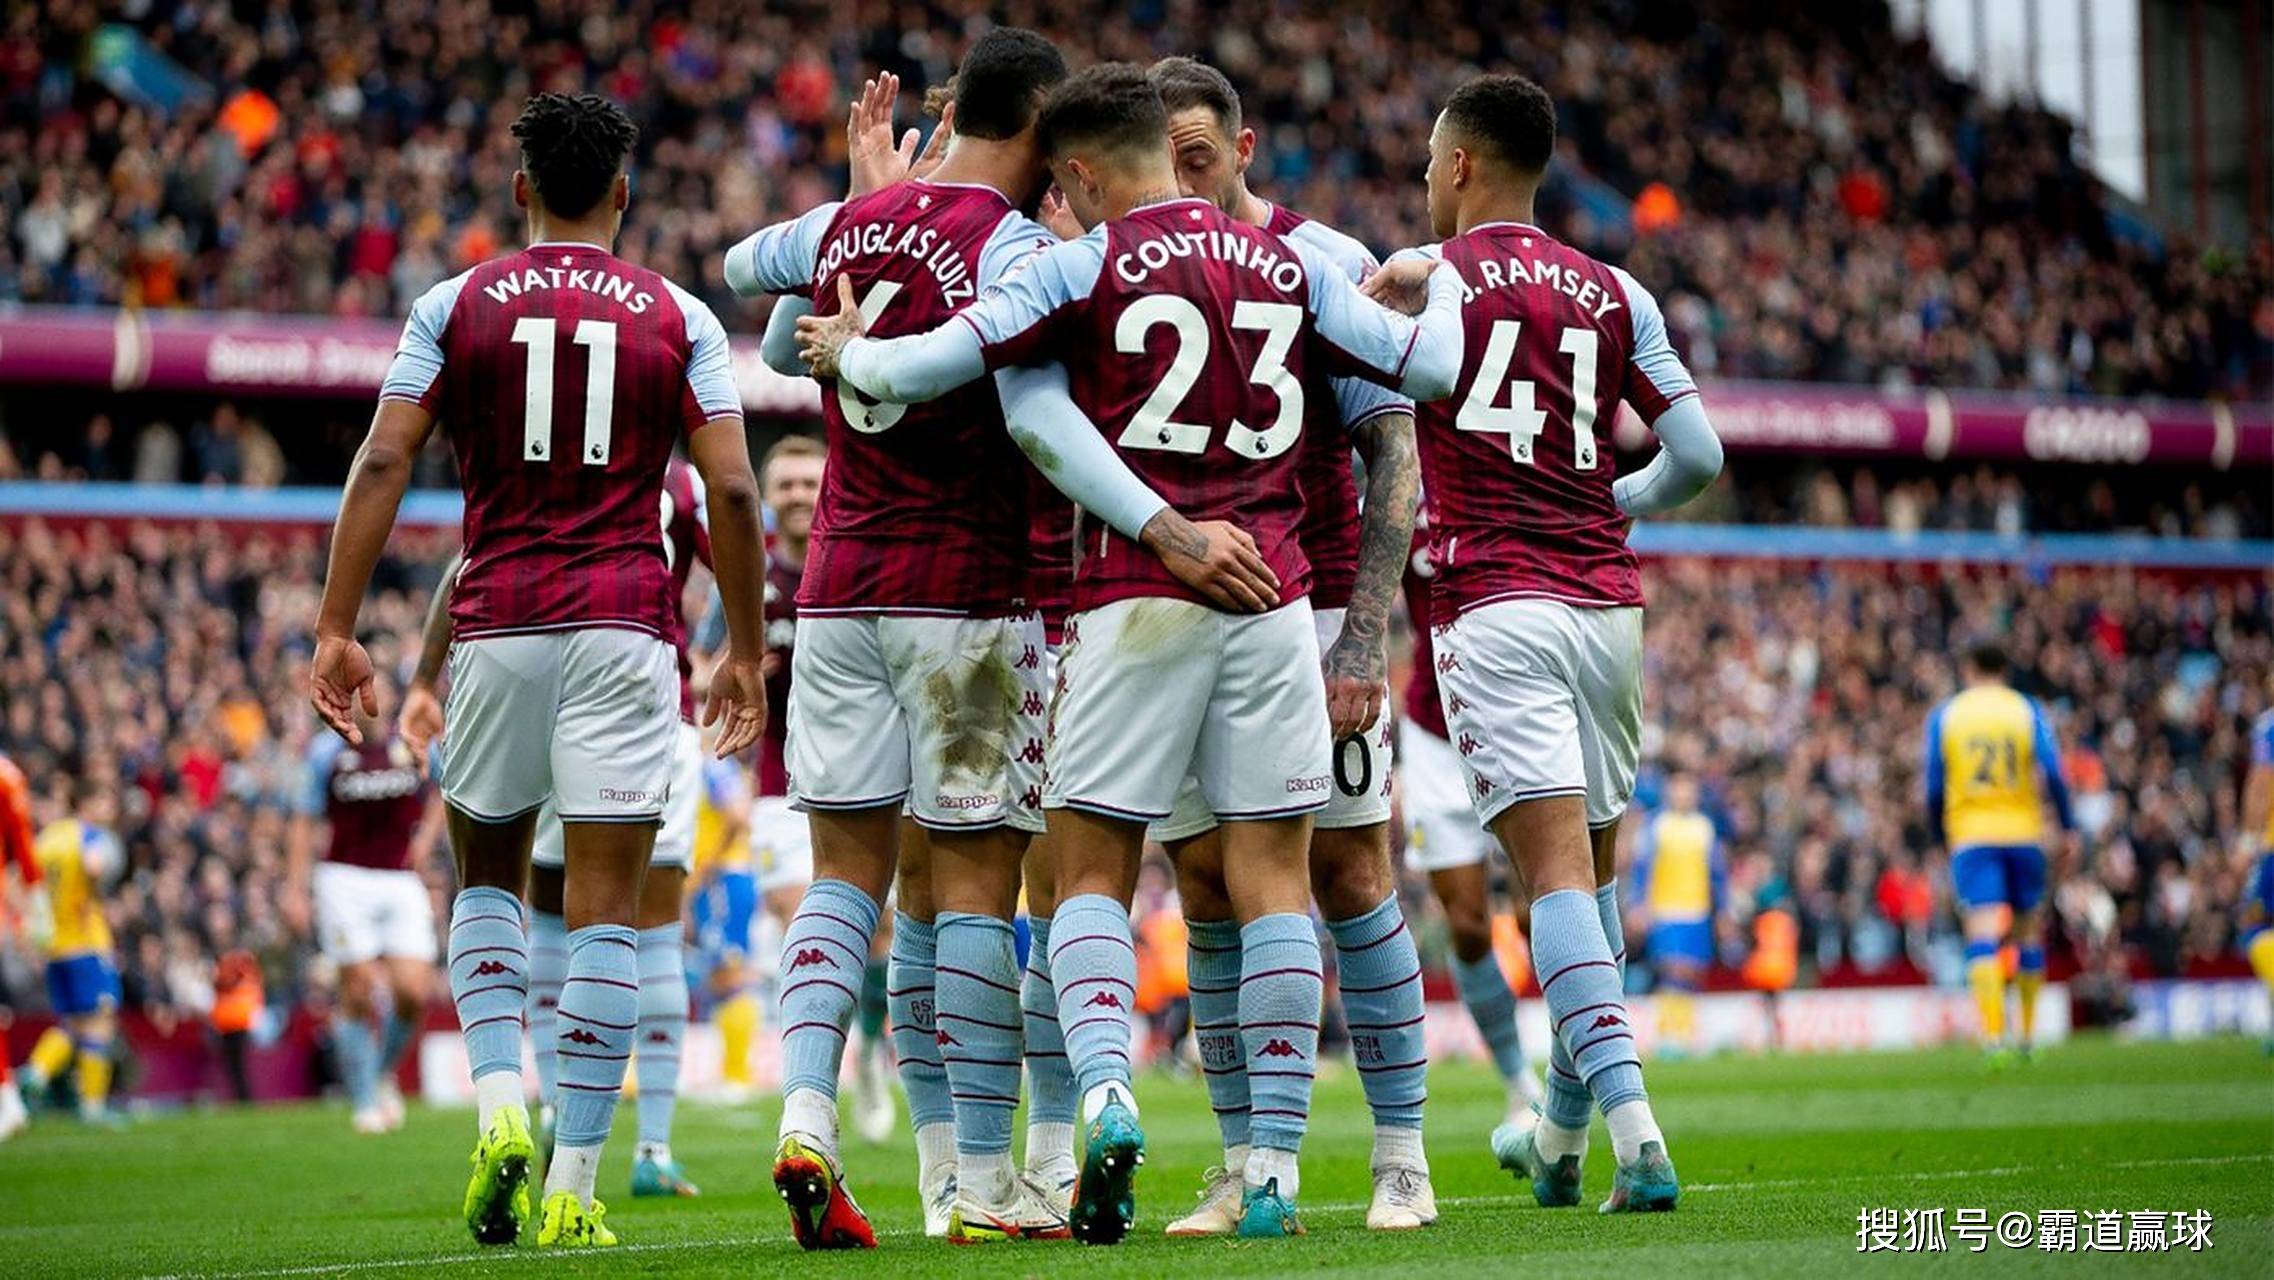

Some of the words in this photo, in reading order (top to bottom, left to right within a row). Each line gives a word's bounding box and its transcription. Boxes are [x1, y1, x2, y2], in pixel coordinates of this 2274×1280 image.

[484, 266, 655, 314] WATKINS
[816, 223, 937, 287] DOUGLAS
[926, 240, 975, 309] LUIZ
[1116, 230, 1303, 293] COUTINHO
[511, 317, 618, 466] 11
[1115, 293, 1305, 460] 23
[1456, 319, 1598, 470] 41
[1967, 735, 2016, 790] 21
